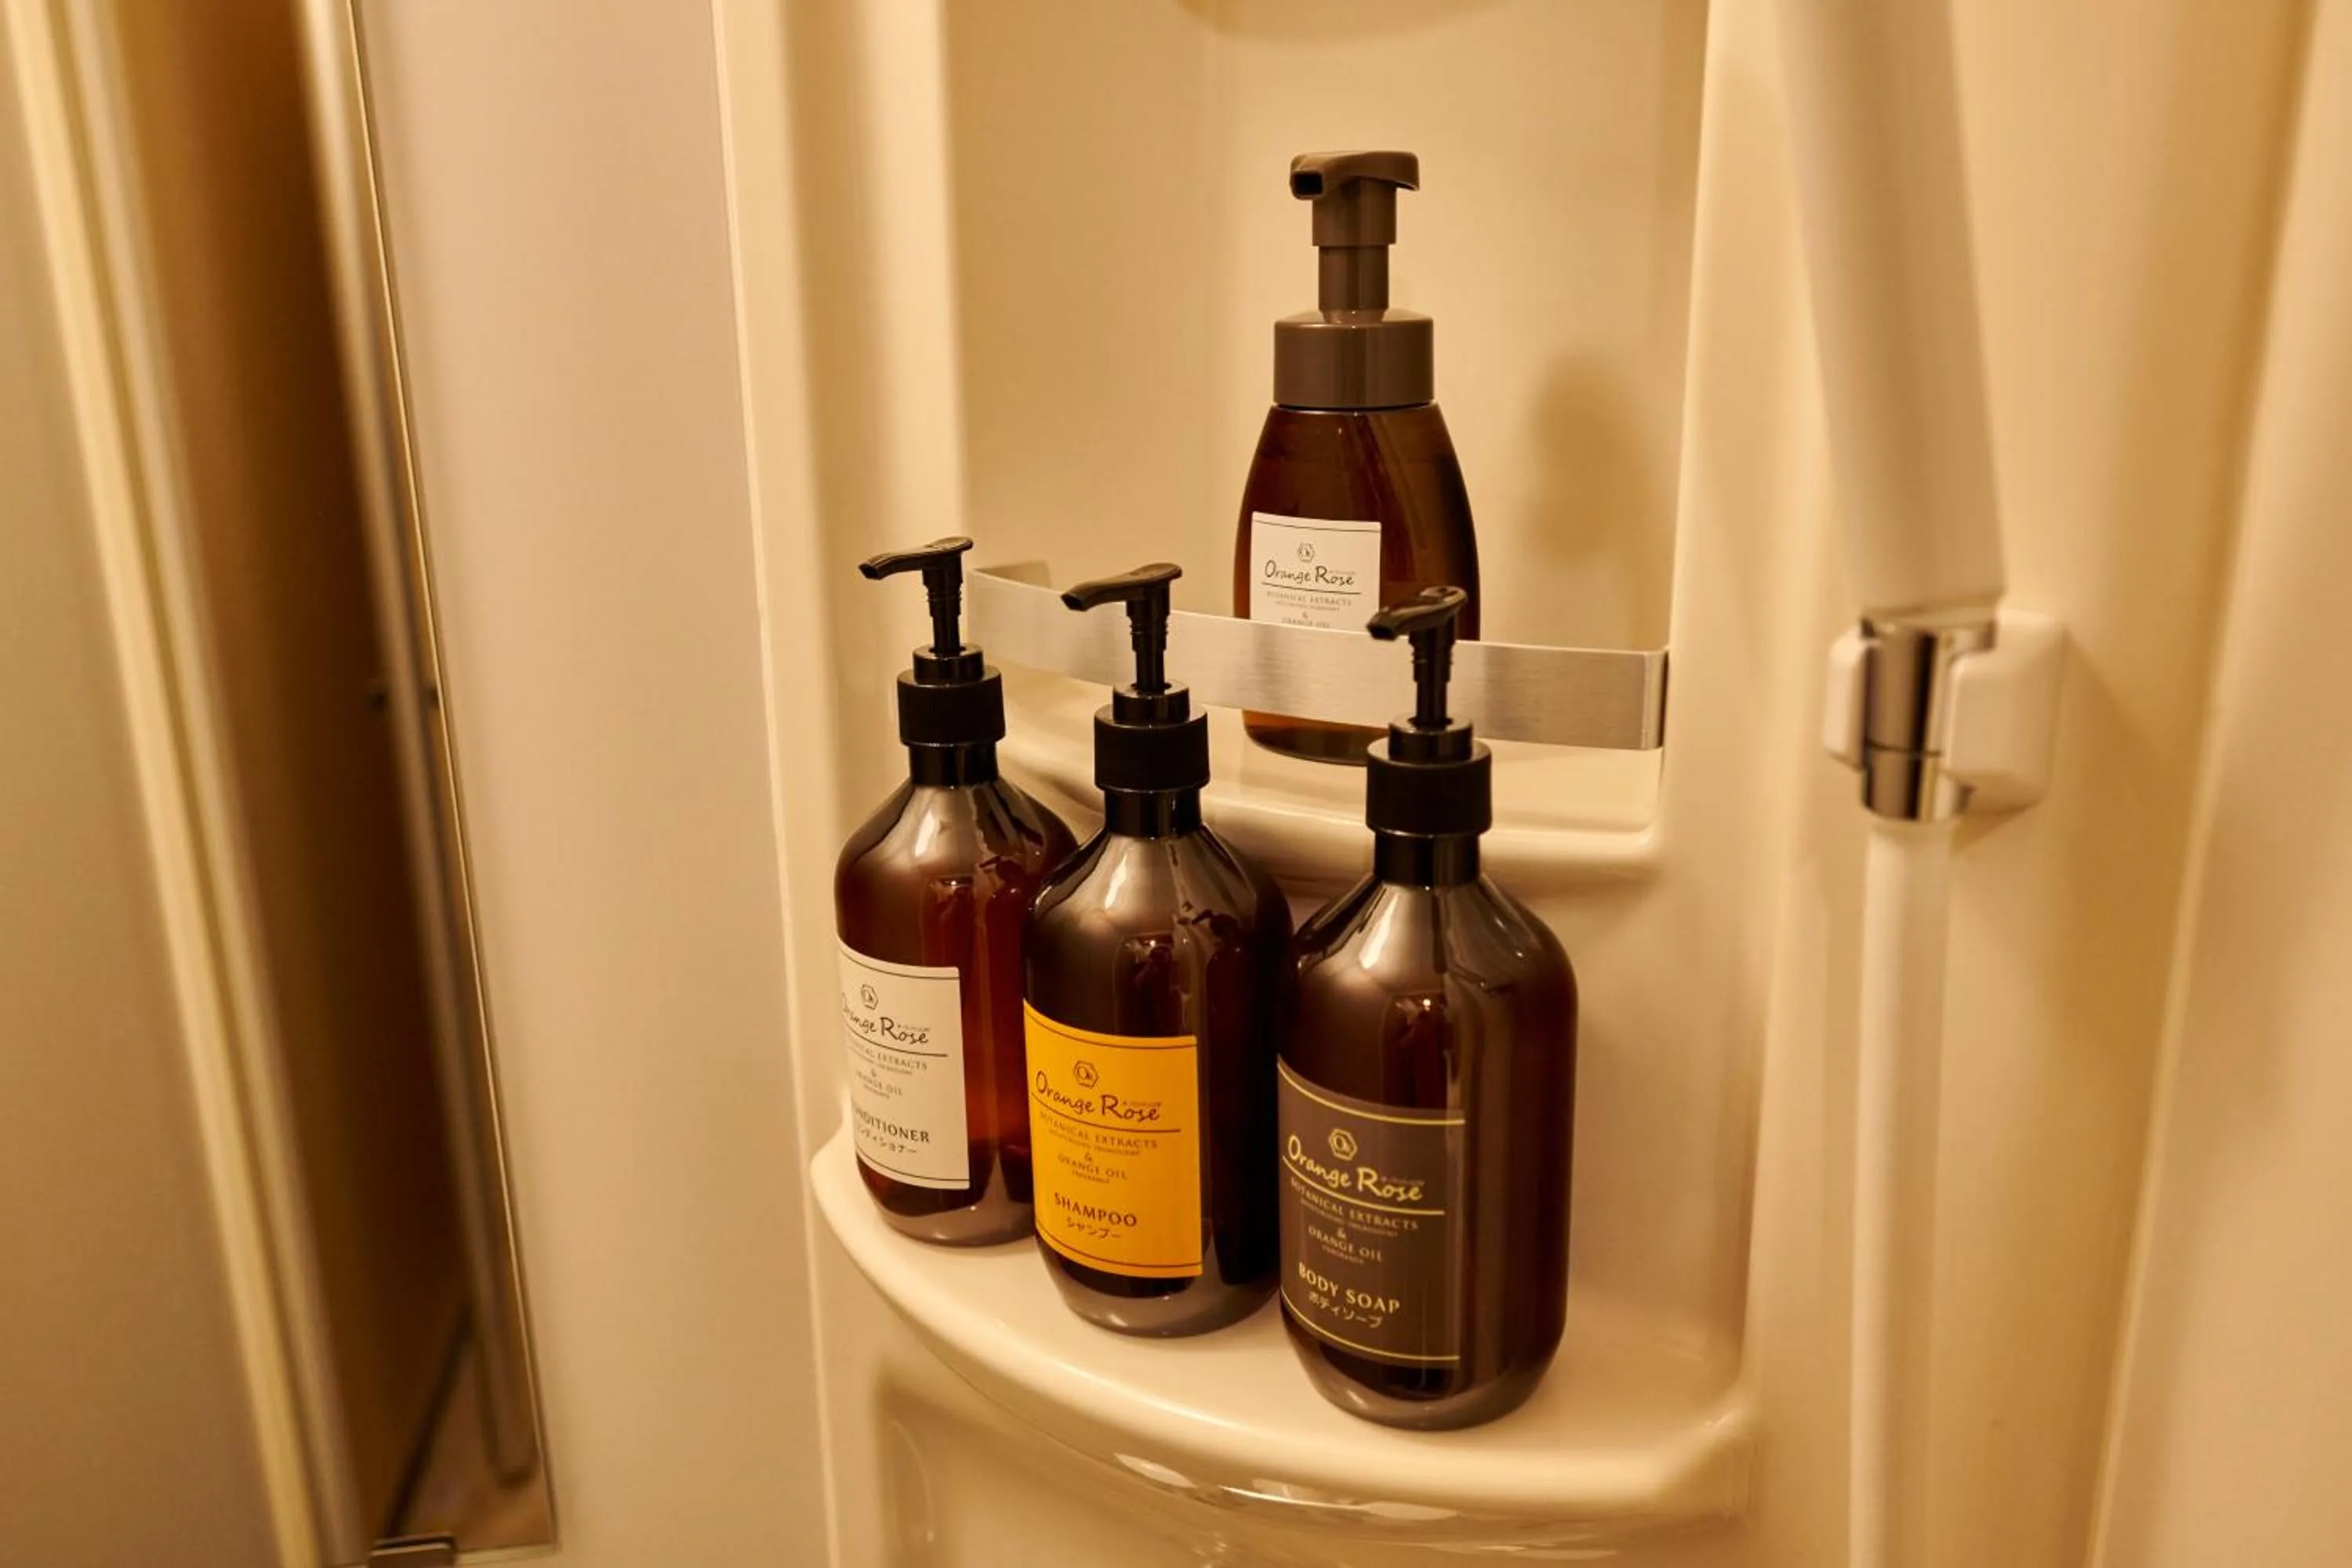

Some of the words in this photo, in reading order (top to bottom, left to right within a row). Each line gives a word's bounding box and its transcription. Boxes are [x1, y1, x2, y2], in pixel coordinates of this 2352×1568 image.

[1265, 559, 1311, 584] Orange
[1315, 565, 1354, 586] Rose
[880, 1017, 929, 1044] Rose
[1036, 1070, 1094, 1115] Orange
[1101, 1094, 1160, 1122] Rose
[1095, 1134, 1157, 1149] EXTRACTS
[1105, 1168, 1127, 1180] OIL
[1288, 1134, 1352, 1189] Orange
[1356, 1166, 1424, 1202] Rose
[1054, 1192, 1137, 1228] SHAMPOO
[1349, 1210, 1418, 1230] EXTRACTS
[1308, 1225, 1354, 1254] ORANGE
[1359, 1247, 1383, 1263] OIL
[1298, 1261, 1339, 1298] BODY
[1345, 1288, 1400, 1314] SOAP
